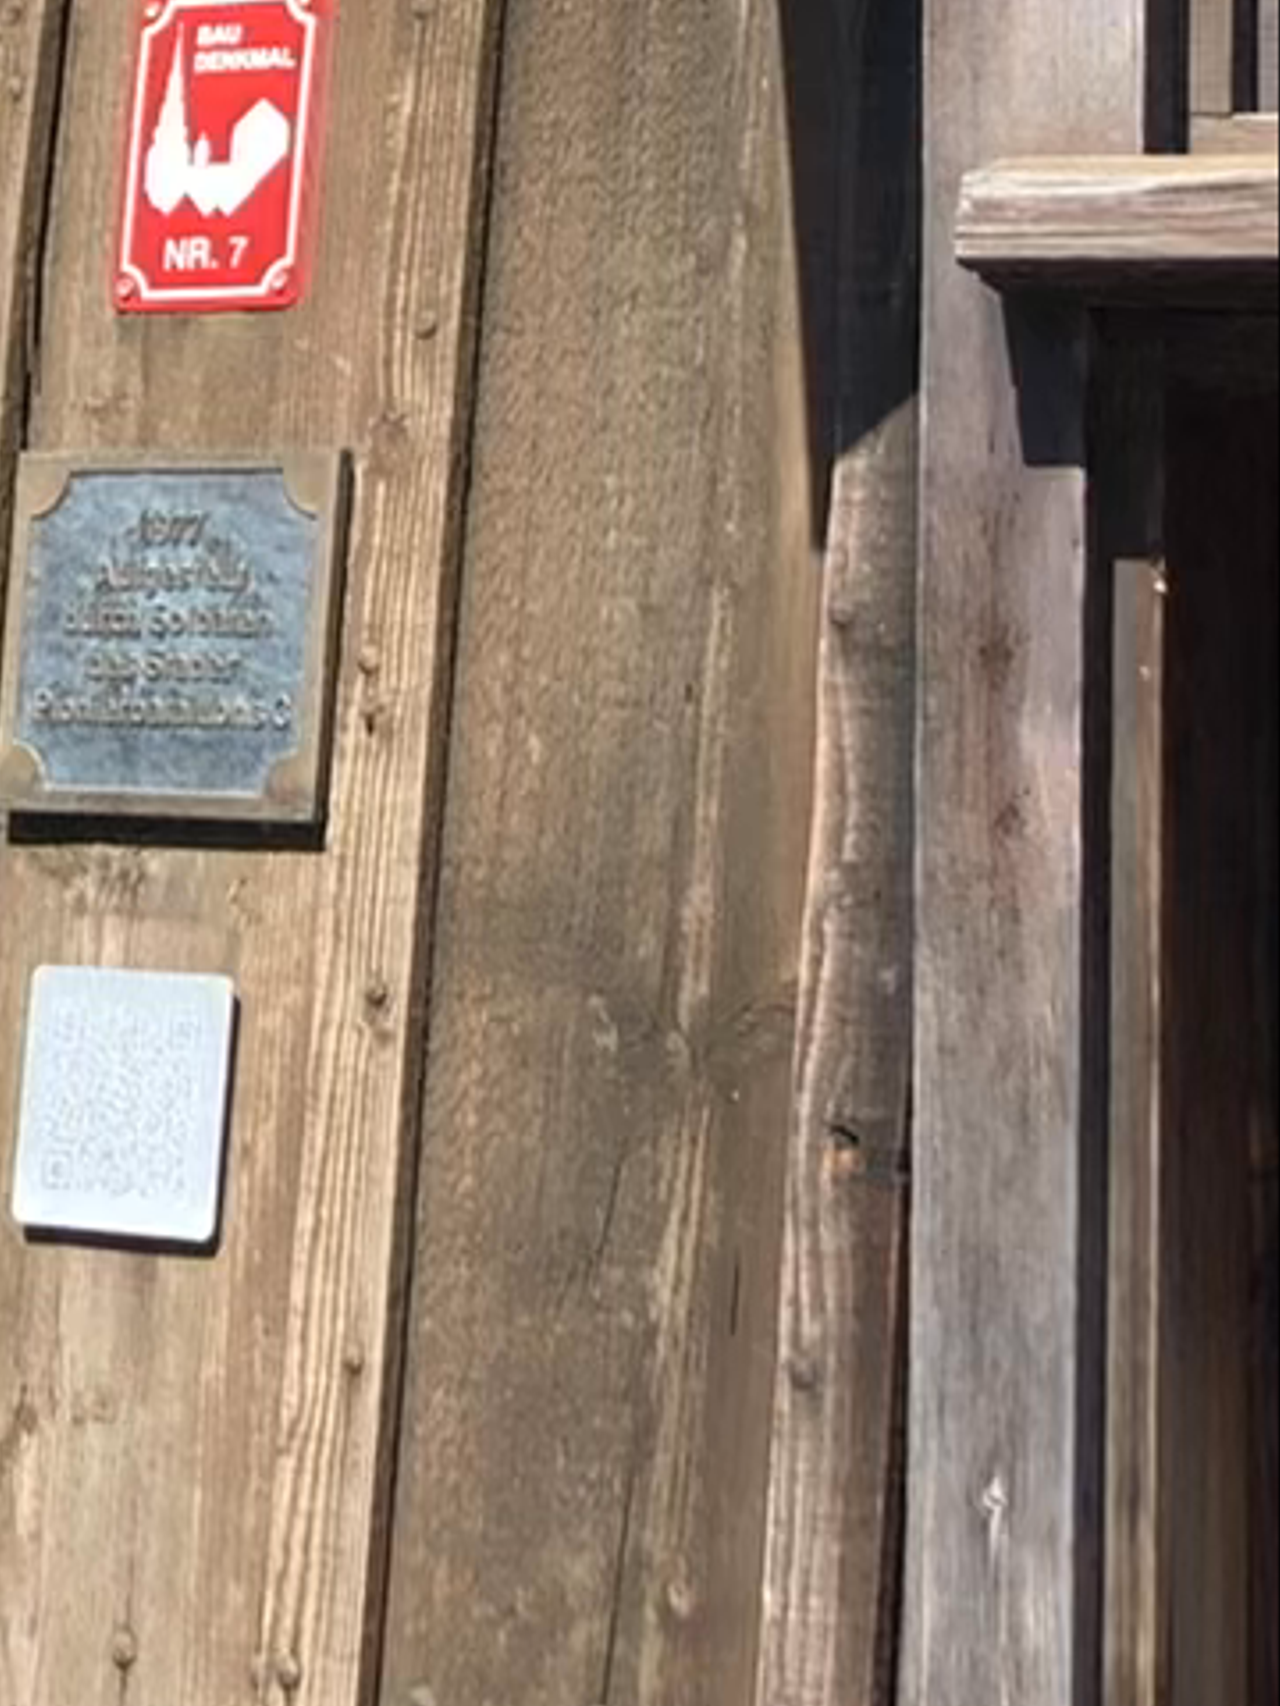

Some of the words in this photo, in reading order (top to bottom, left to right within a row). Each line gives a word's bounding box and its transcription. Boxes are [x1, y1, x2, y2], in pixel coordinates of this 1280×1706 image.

[197, 23, 243, 46] BAU
[193, 47, 297, 74] DENKMAL
[162, 236, 219, 272] NR.
[228, 236, 250, 269] 7
